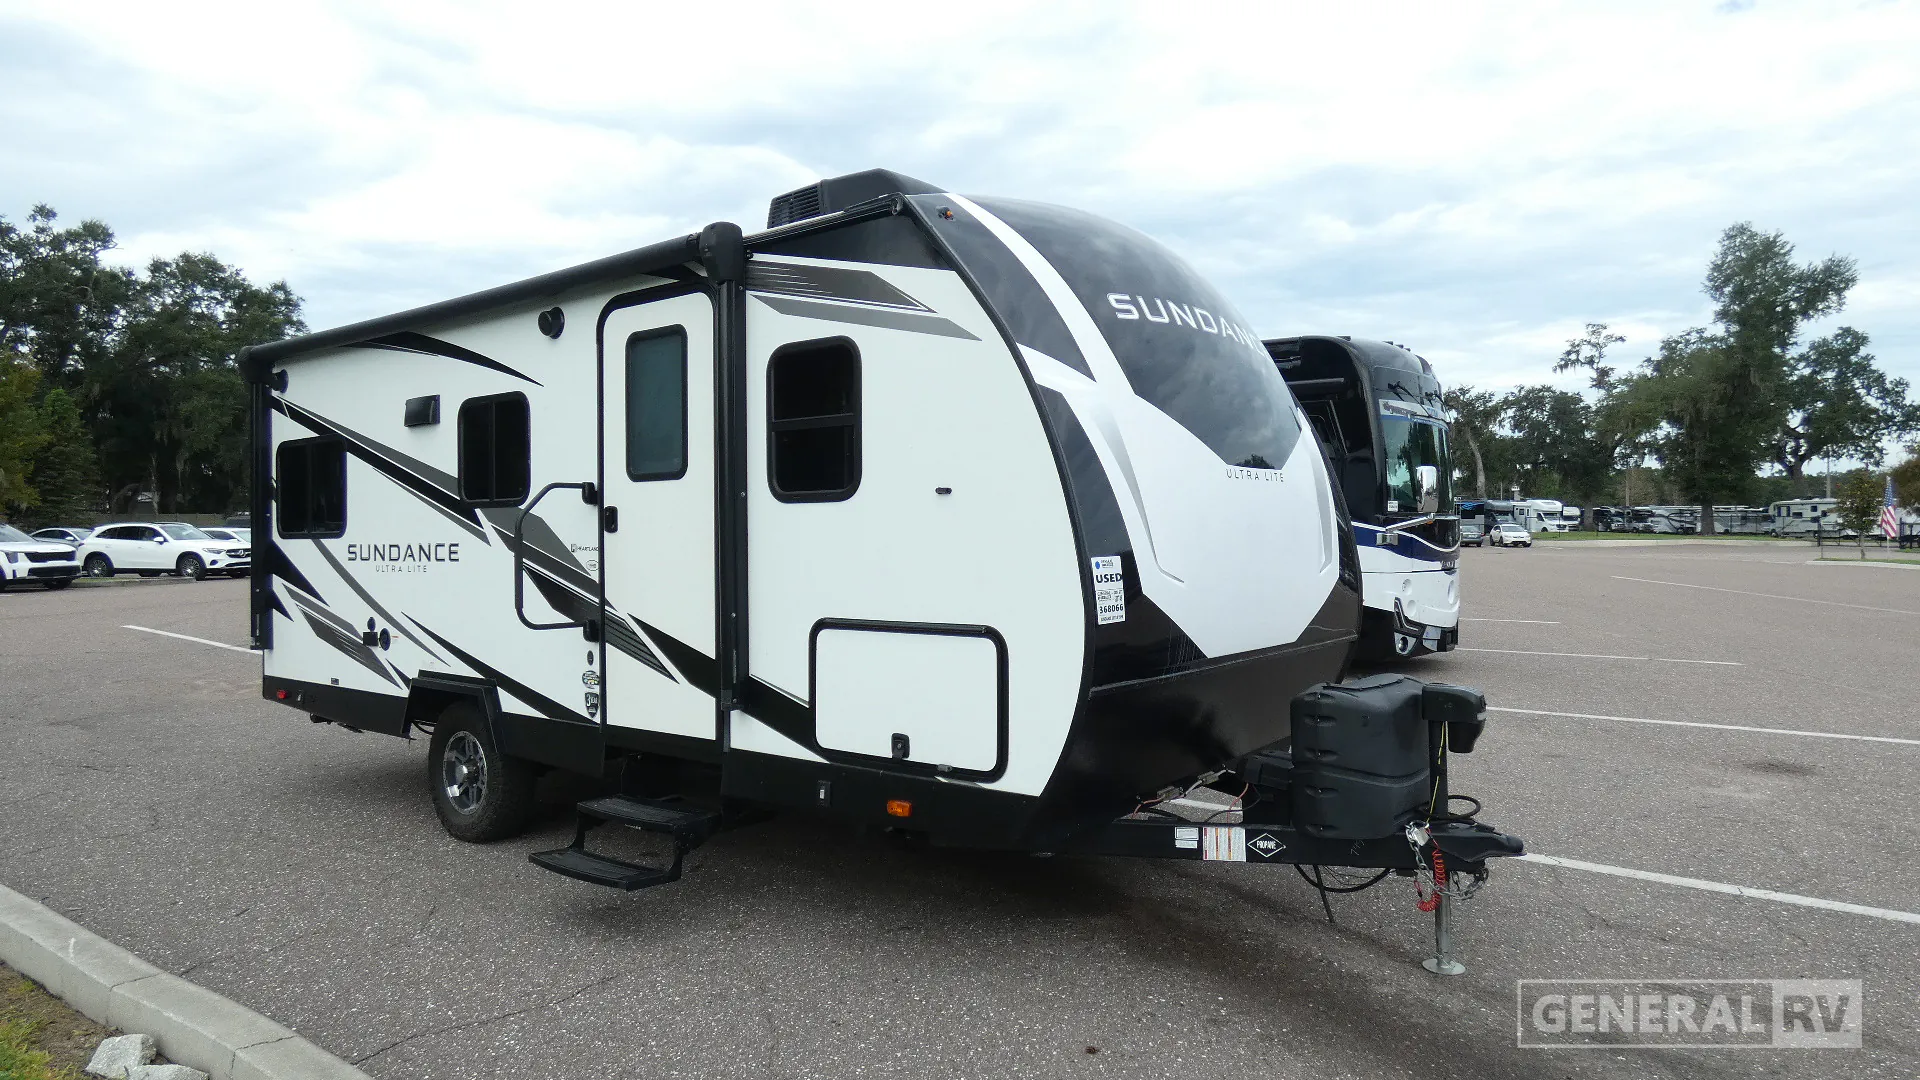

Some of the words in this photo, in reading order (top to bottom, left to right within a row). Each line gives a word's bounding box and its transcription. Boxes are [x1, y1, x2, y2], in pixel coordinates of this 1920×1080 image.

[1226, 468, 1260, 481] ULTRA
[1264, 472, 1285, 483] LITE
[347, 542, 460, 562] SUNDANCE
[375, 564, 403, 573] ULTRA
[407, 565, 427, 573] LITE
[1096, 572, 1122, 584] USED
[1256, 840, 1276, 850] PROPANE
